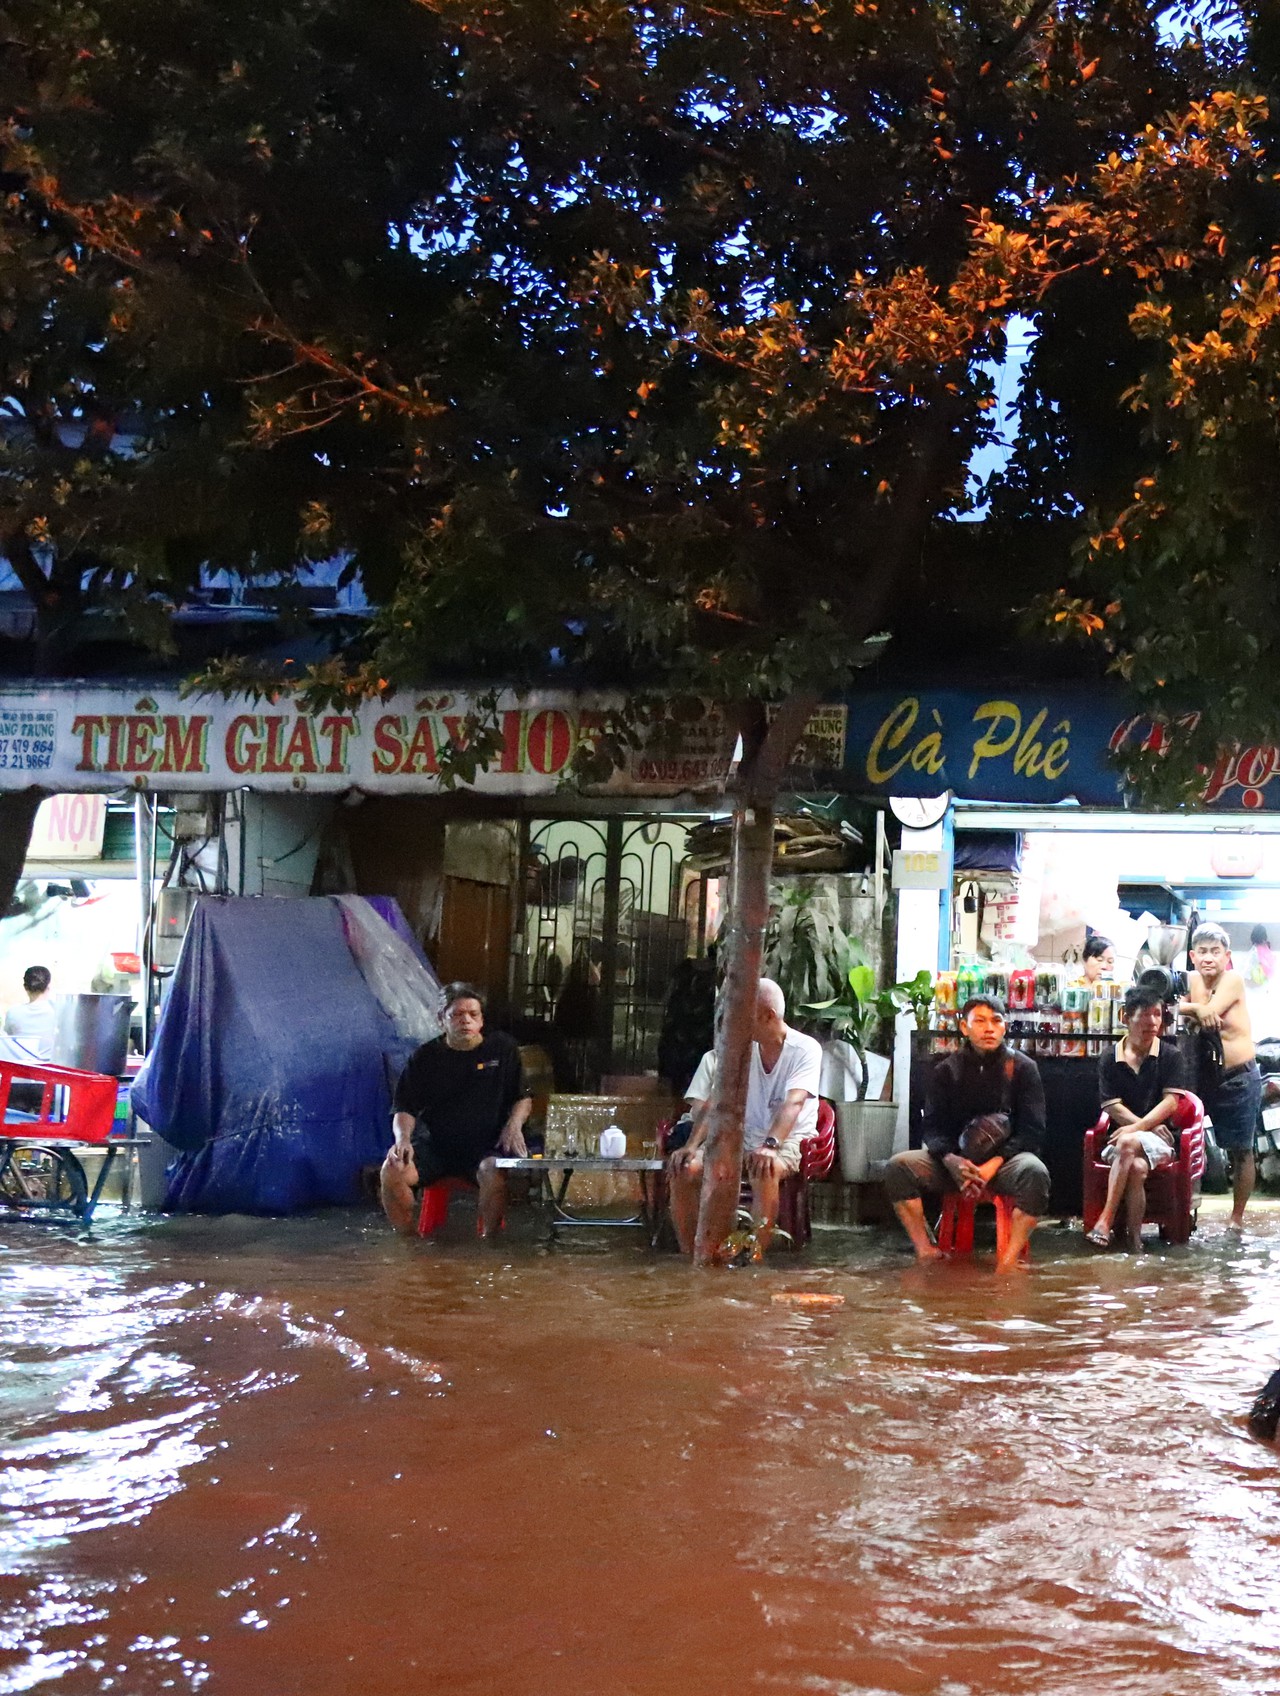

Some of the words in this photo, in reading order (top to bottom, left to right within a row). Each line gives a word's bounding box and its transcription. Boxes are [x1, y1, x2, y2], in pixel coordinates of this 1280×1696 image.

[21, 723, 55, 738] TRUNG
[0, 740, 9, 753] 7
[12, 740, 29, 753] 479
[32, 740, 53, 754] 864
[71, 697, 211, 788] TIỆM
[866, 697, 946, 785] Cà
[968, 700, 1070, 781] Phê
[11, 755, 23, 769] 21
[904, 853, 939, 873] 105
